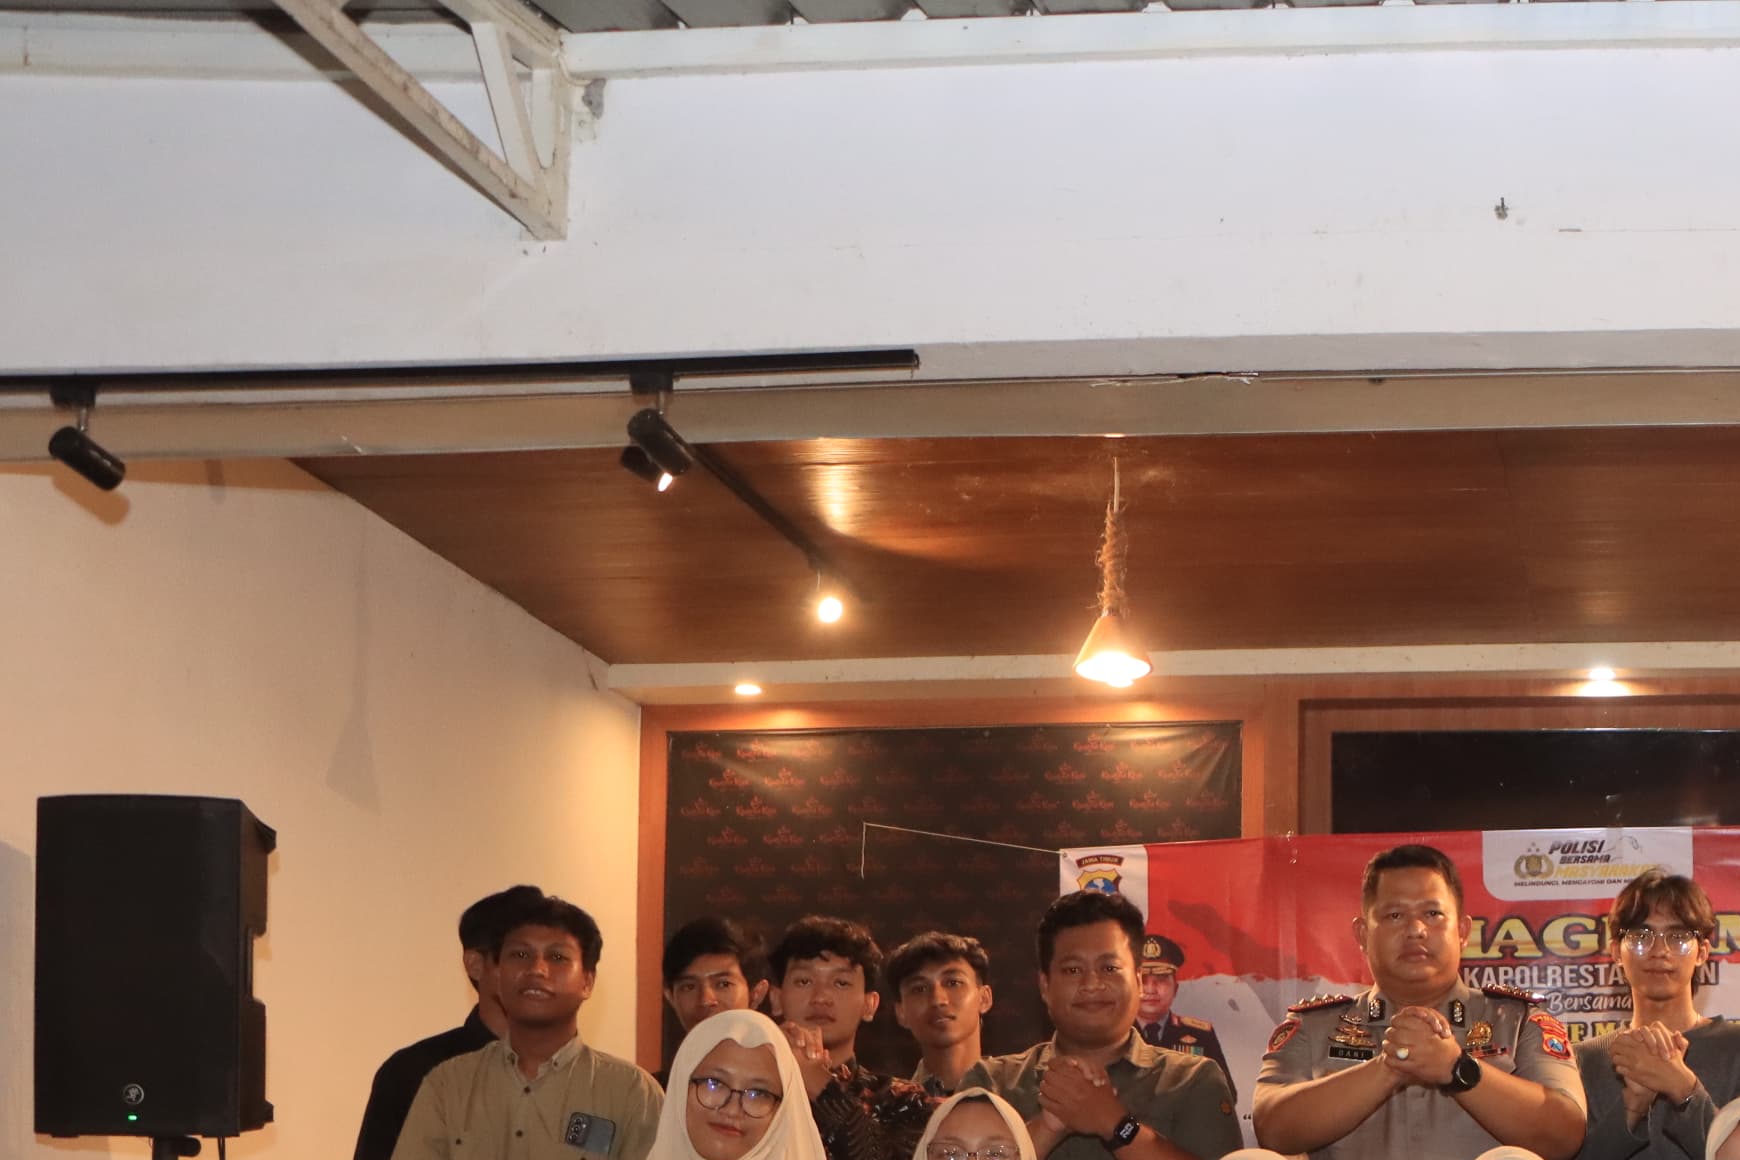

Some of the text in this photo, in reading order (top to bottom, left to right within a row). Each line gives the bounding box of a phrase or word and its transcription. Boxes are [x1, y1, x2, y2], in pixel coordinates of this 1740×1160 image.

[1548, 839, 1606, 855] POLISI
[1559, 854, 1611, 864] BERSAMA
[1548, 992, 1633, 1015] Bersama
